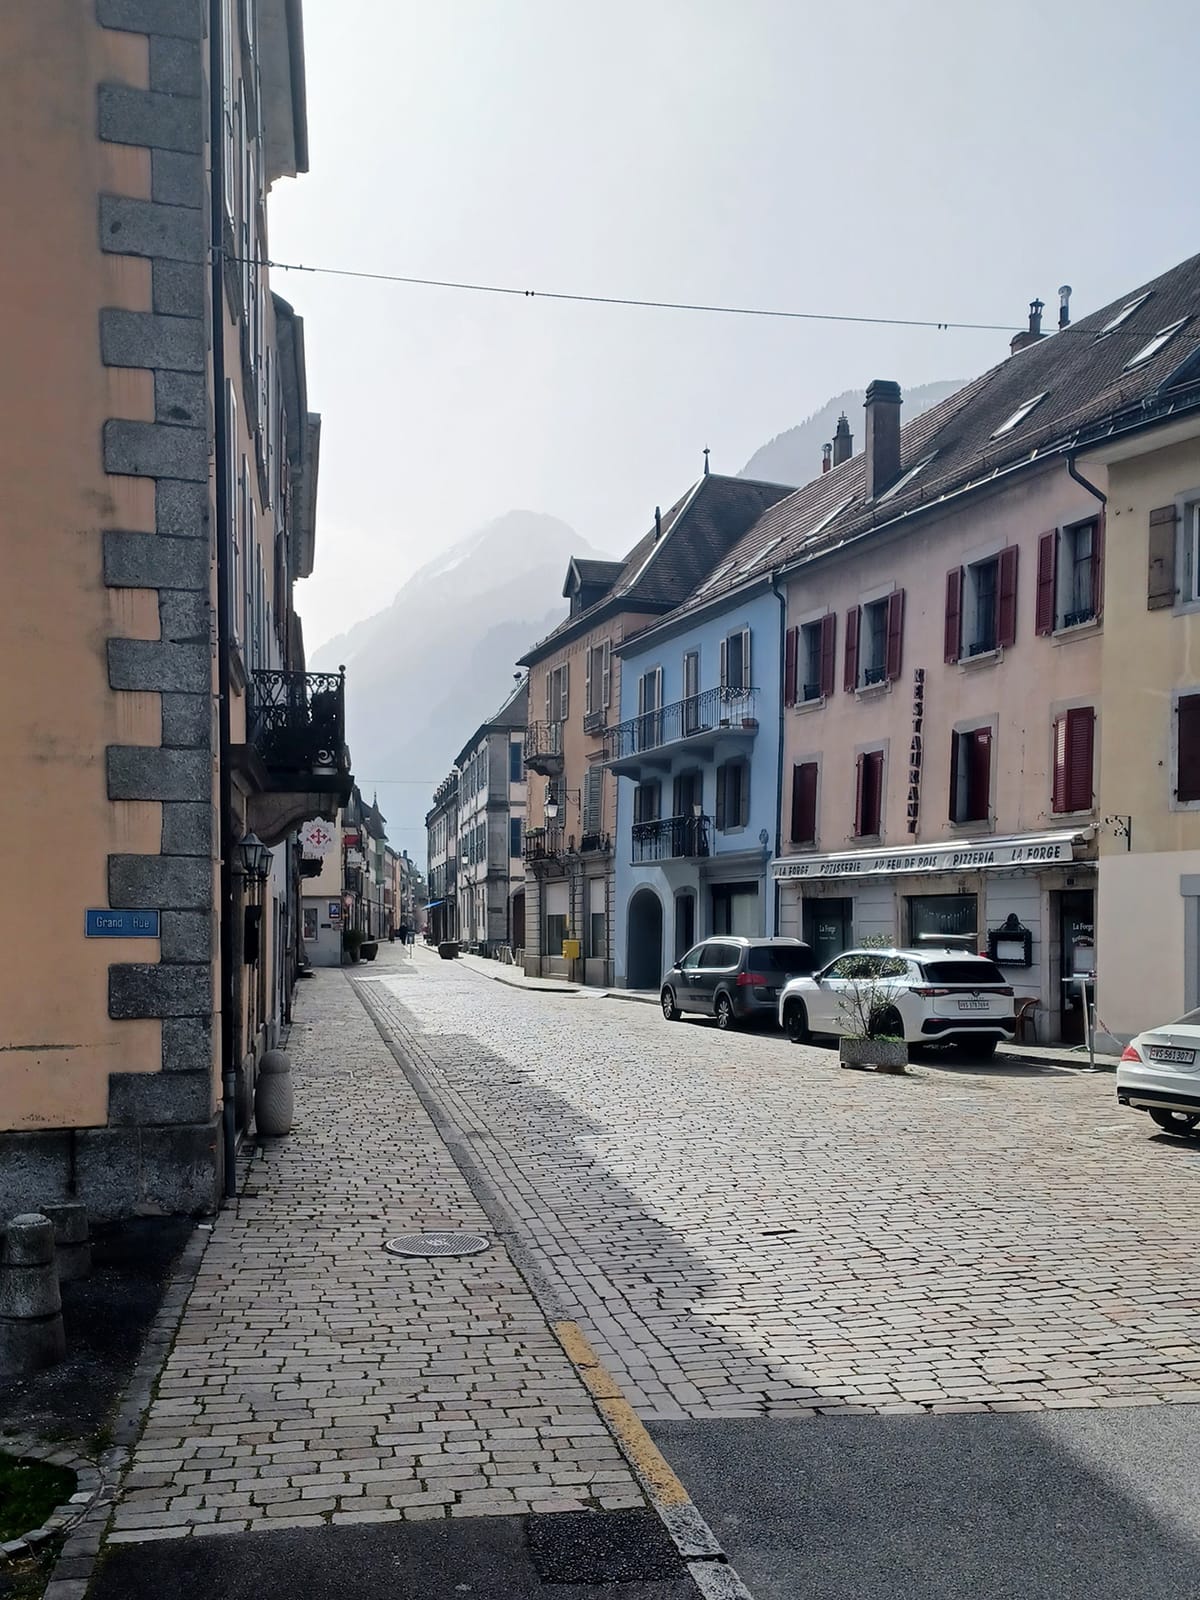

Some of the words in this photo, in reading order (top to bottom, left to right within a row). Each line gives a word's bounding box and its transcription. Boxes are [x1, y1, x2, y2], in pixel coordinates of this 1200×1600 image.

[907, 668, 925, 834] RESTAURANT
[887, 859, 901, 870] FEU
[953, 851, 994, 866] PIZZERIA
[1012, 848, 1023, 861] LA
[1027, 846, 1061, 860] FORGE
